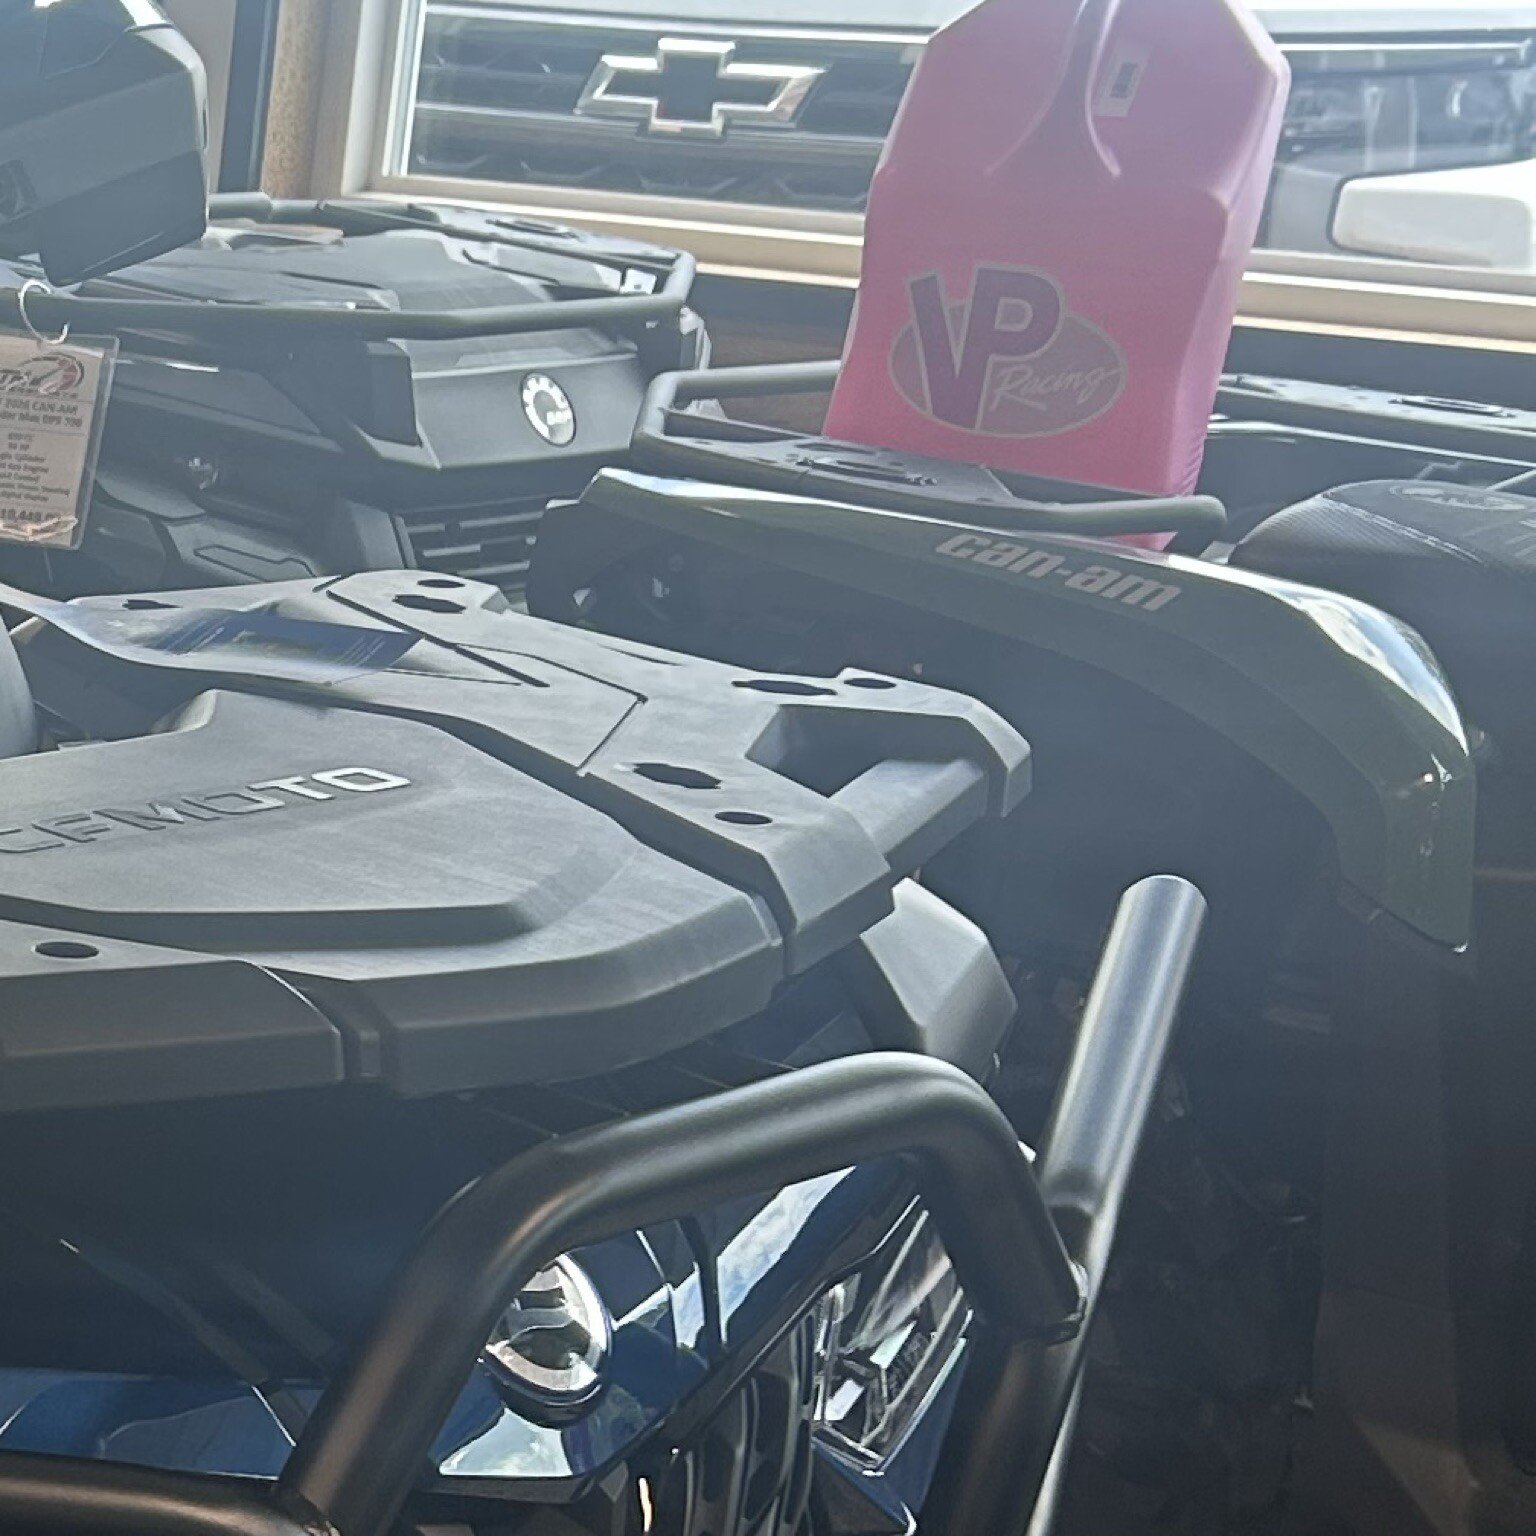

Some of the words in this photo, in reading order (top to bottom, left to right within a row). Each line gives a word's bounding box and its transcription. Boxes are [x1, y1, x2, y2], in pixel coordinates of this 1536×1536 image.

[905, 261, 1065, 432] VP
[989, 365, 1121, 413] Racing
[935, 533, 1182, 611] can-am
